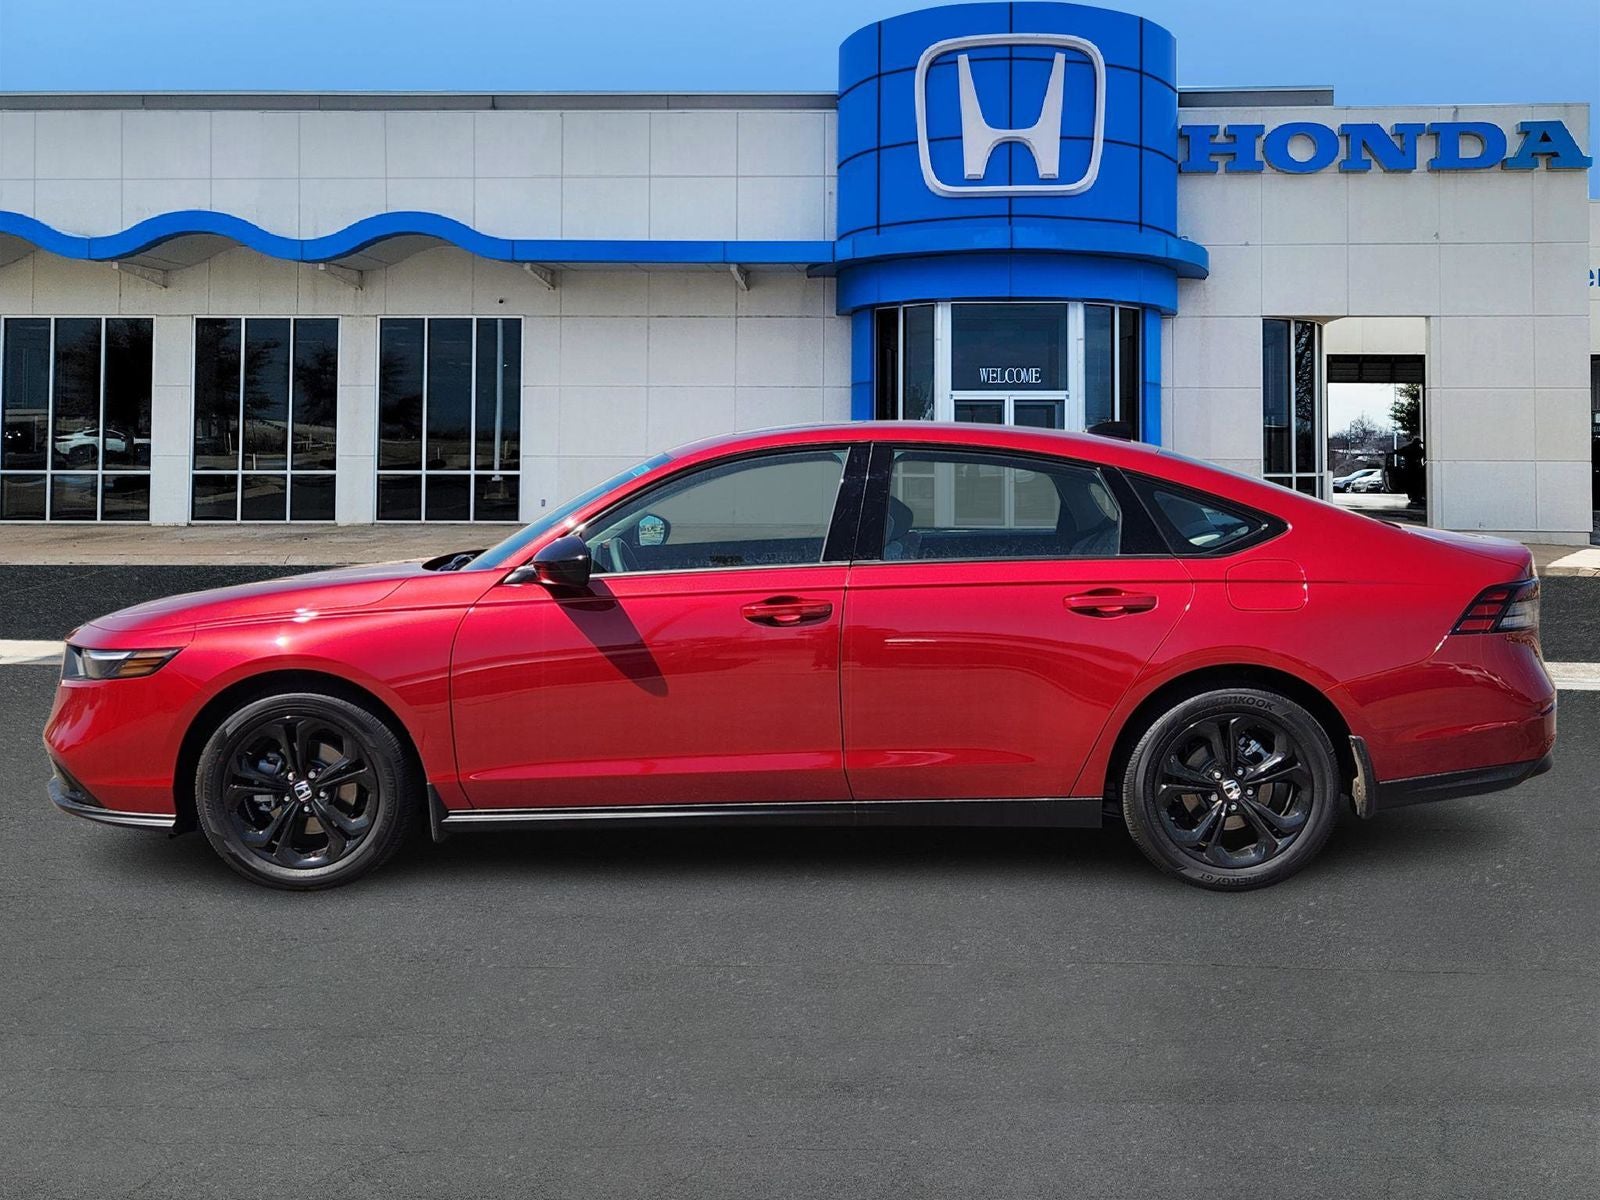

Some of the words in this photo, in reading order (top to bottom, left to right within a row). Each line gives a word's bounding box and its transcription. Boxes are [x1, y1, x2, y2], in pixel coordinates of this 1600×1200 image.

[1178, 120, 1592, 173] HONDA
[979, 367, 1041, 384] WELCOME
[1211, 695, 1275, 711] NKOOK
